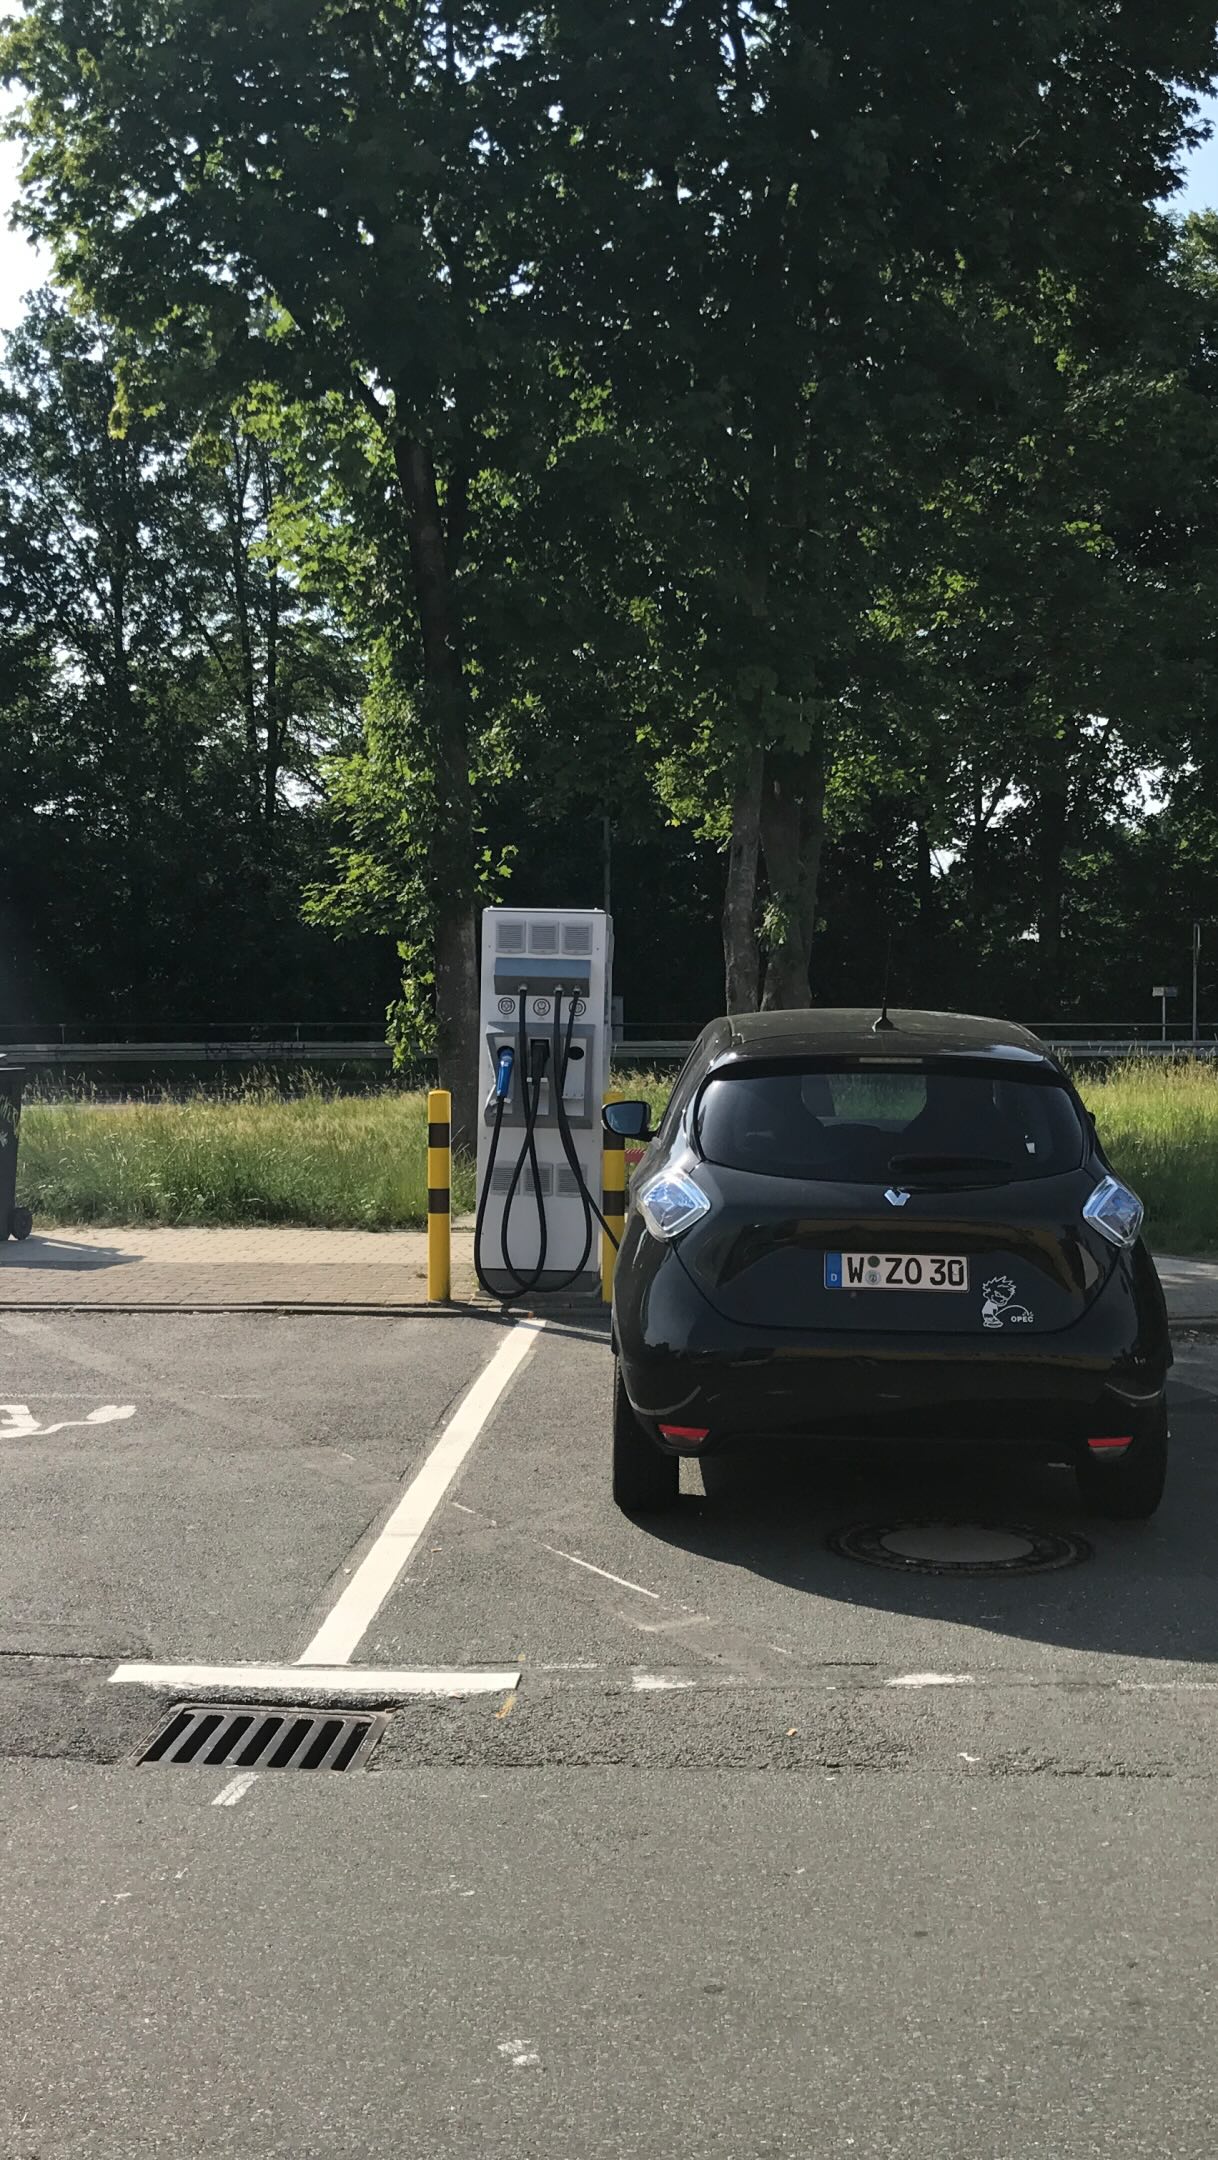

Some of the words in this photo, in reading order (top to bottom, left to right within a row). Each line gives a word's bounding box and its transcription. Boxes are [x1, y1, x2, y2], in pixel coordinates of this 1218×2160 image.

[830, 1273, 838, 1281] D
[847, 1257, 865, 1283] W
[885, 1257, 922, 1285] ZO
[929, 1259, 964, 1286] 30
[1010, 1315, 1034, 1323] OPEC
